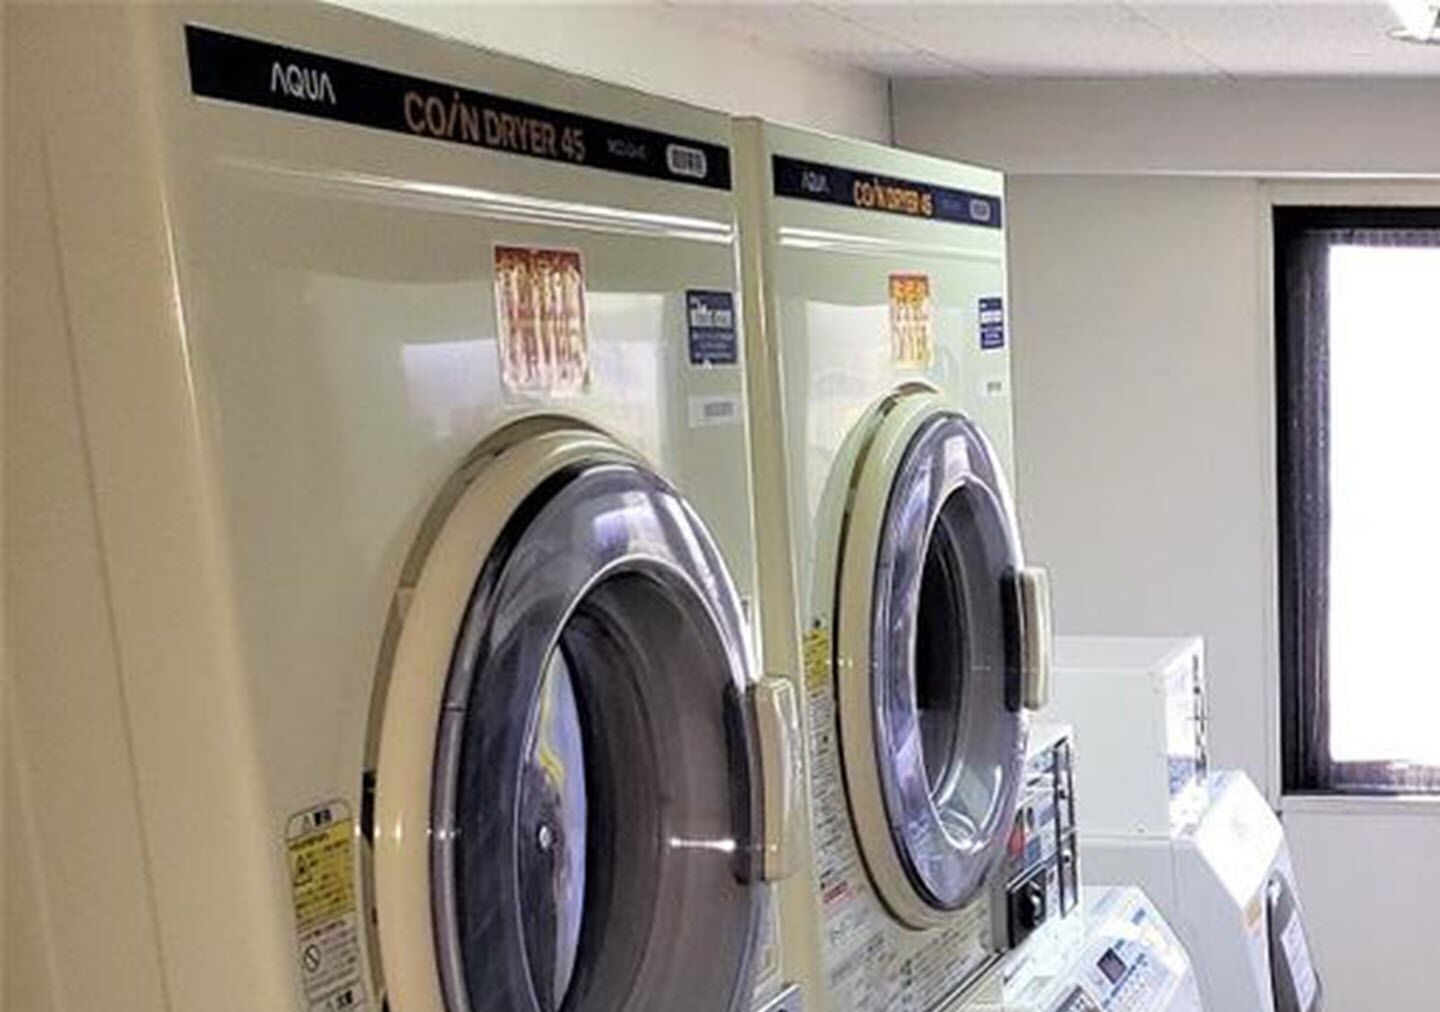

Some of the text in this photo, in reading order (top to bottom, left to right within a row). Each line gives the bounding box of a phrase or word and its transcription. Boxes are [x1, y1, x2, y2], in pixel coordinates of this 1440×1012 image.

[270, 60, 337, 105] AQUA
[482, 108, 558, 157] DRYER
[560, 127, 587, 163] 45
